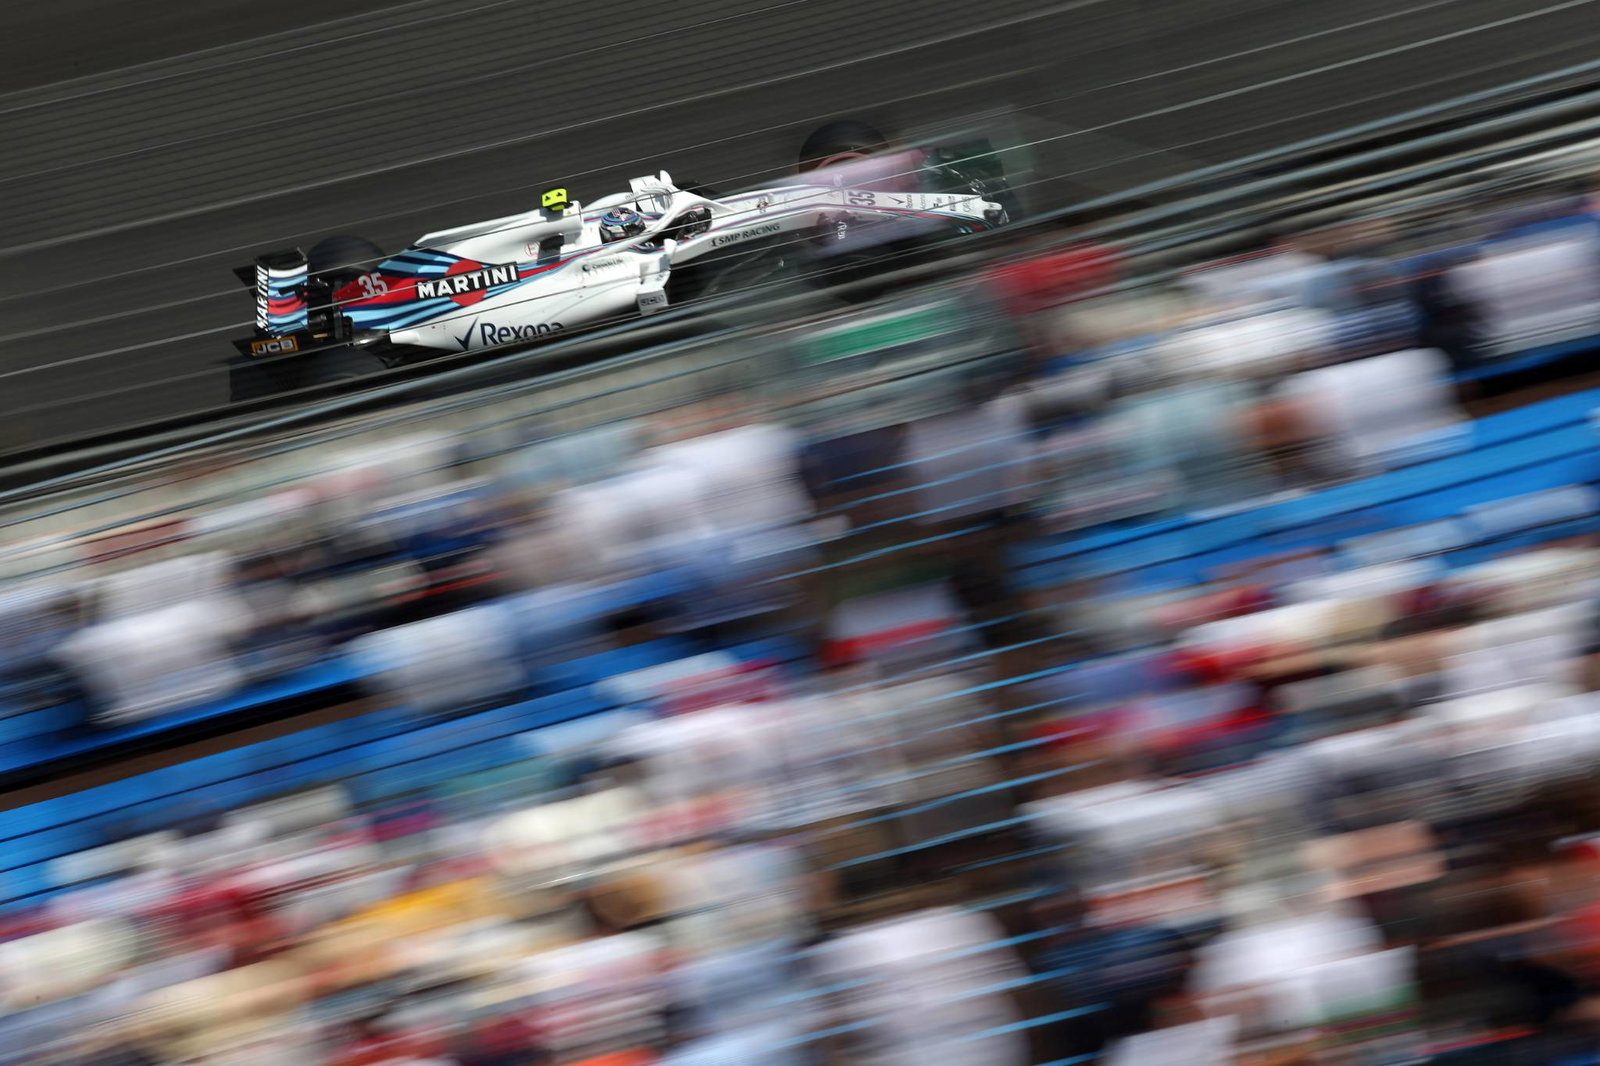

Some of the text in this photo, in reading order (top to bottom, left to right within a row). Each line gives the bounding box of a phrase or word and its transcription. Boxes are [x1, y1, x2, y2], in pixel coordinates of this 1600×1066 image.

[849, 191, 876, 206] 35
[719, 222, 780, 245] SMP RACING
[357, 272, 388, 298] 35
[417, 264, 518, 299] MARTINI
[256, 264, 269, 332] MARTINI
[256, 339, 294, 354] JCB
